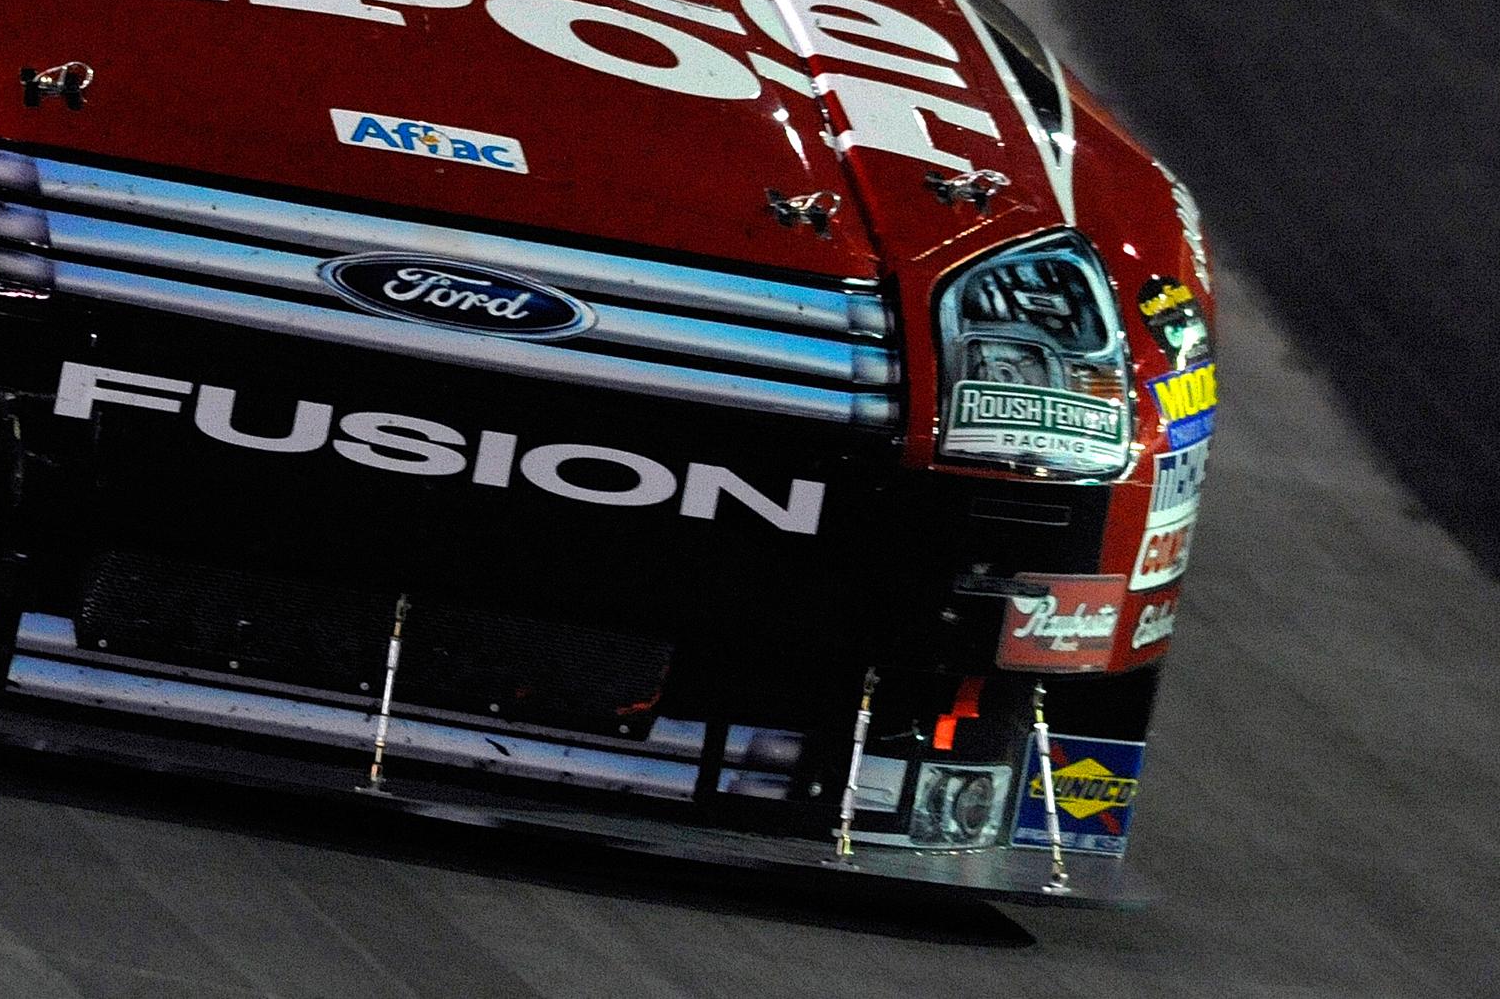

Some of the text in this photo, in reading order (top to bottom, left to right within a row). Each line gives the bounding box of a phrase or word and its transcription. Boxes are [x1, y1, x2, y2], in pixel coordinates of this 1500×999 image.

[350, 114, 516, 171] Aflac
[383, 266, 530, 322] Ford
[960, 389, 1042, 427] ROUSH
[54, 361, 826, 536] FUSION
[1003, 433, 1087, 453] RACING
[1031, 775, 1132, 803] UNOCO
